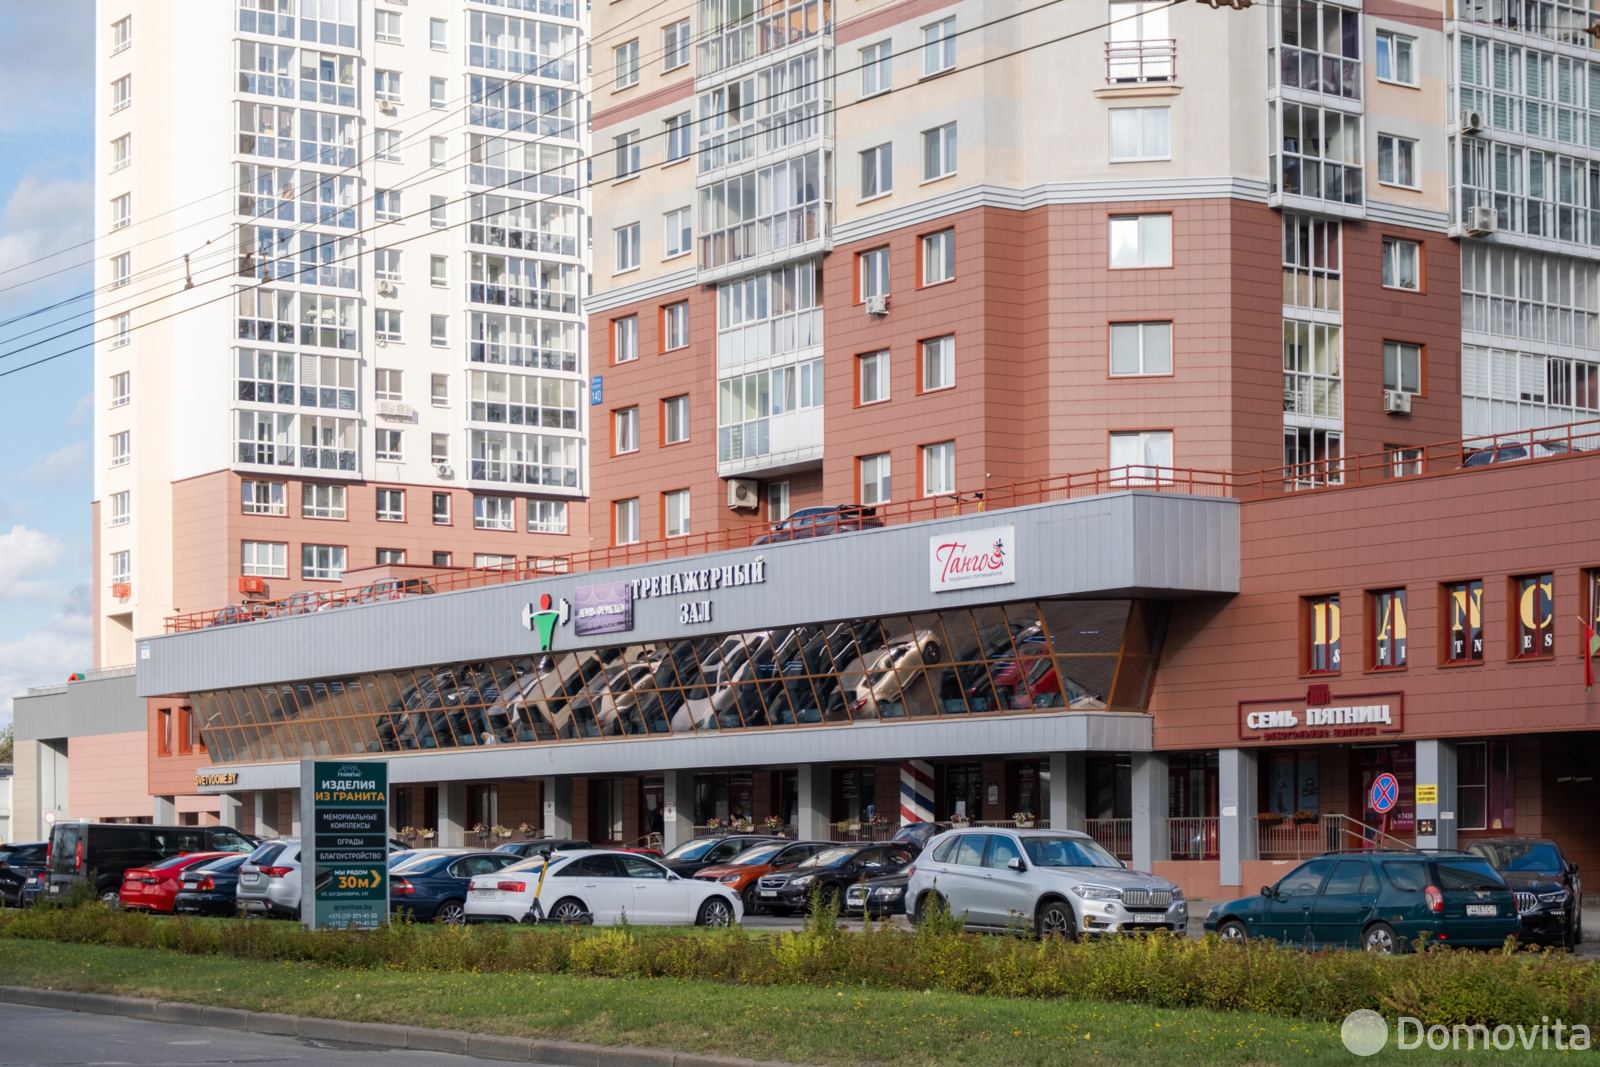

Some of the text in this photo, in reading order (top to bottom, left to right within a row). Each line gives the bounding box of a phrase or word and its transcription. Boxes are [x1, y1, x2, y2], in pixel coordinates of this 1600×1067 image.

[592, 390, 602, 403] 140
[936, 541, 989, 582] Танго
[631, 555, 766, 599] ТРЕНАЖЕРНЫЙ
[680, 601, 712, 624] ЗАЛ
[1313, 578, 1600, 645] DANC
[1380, 633, 1553, 660] FITNES
[1247, 705, 1392, 729] СЕМЬ ПЯТНИЦ
[1333, 727, 1377, 736] напитки
[195, 773, 238, 786] SVETVDOME.BY
[322, 780, 376, 791] ИЗДЕЛИЯ
[315, 792, 385, 801] ИЗ ГРАНИТА
[320, 851, 382, 860] БЛАГОУСТРОЙСТВО
[333, 903, 373, 911] granitas.by
